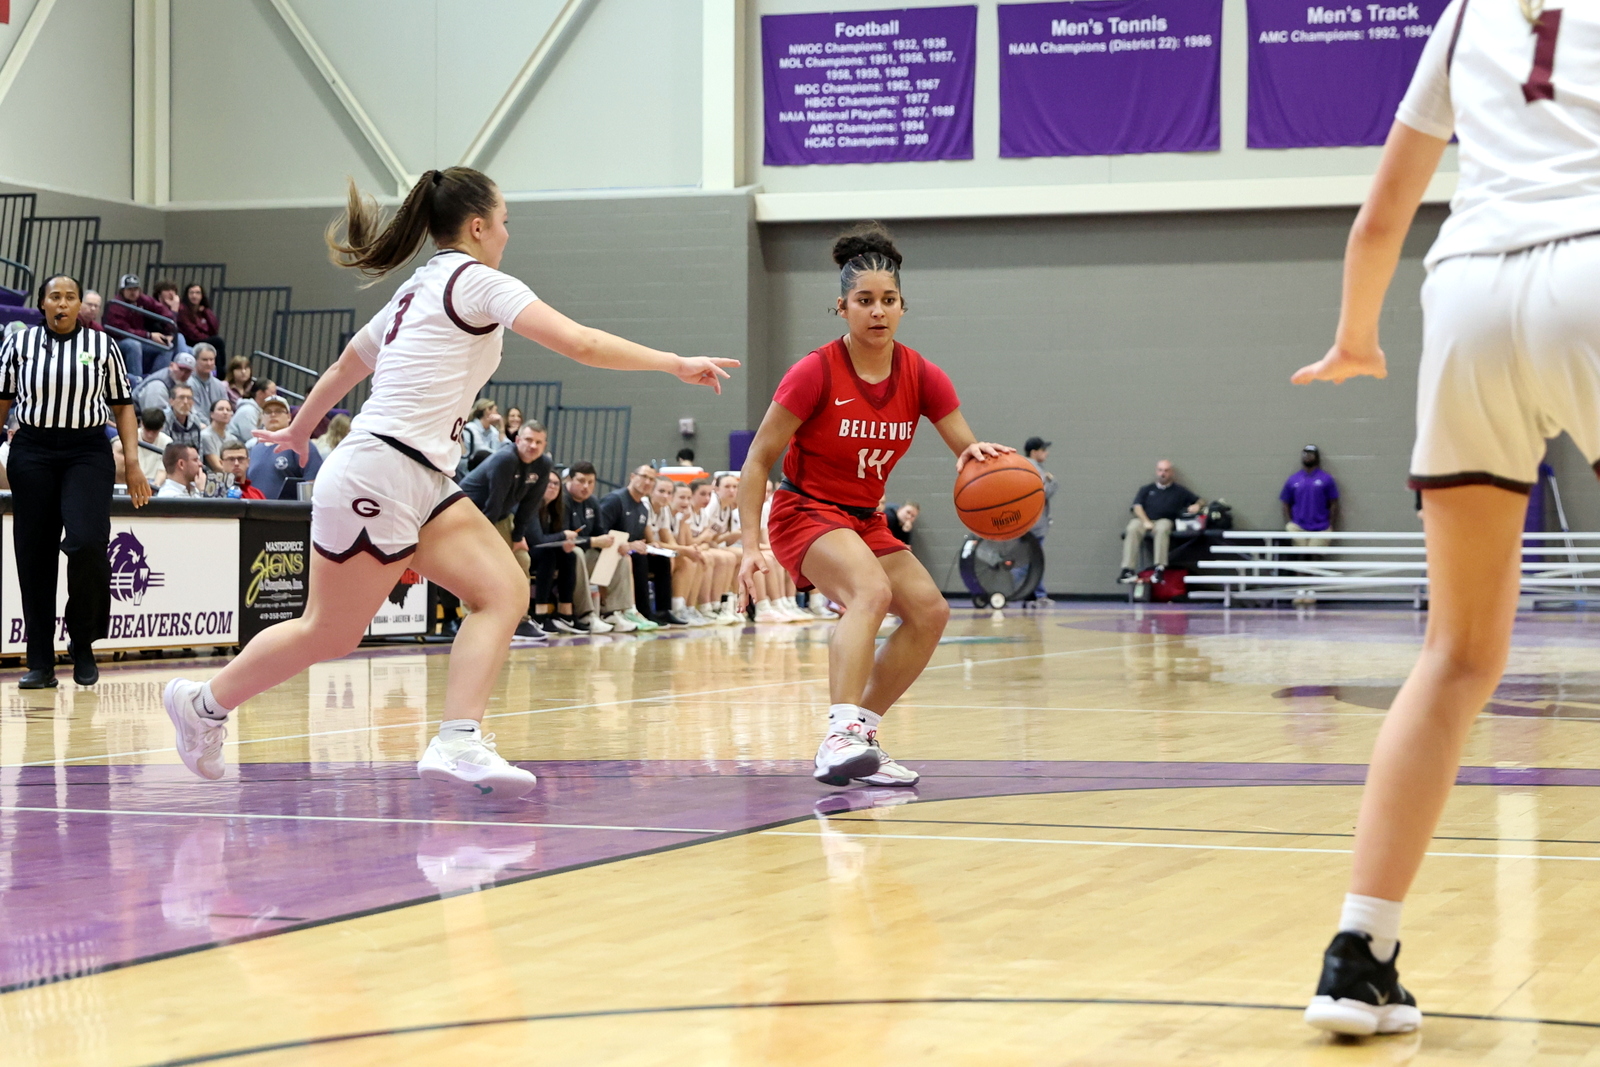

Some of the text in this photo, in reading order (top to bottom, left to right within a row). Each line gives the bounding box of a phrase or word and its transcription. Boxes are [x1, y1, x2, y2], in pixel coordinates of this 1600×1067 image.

[1307, 2, 1419, 24] Men's Track
[835, 20, 899, 38] Football
[1051, 14, 1167, 37] Men's Tennis
[1259, 30, 1288, 44] AMC
[1290, 29, 1365, 44] Champions:
[1368, 26, 1400, 40] 1992,
[825, 41, 887, 54] Champions:
[1008, 42, 1039, 55] NAIA
[1040, 41, 1107, 55] Champions
[1108, 37, 1156, 54] (District
[805, 55, 867, 69] Champions:
[1521, 8, 1563, 104] 1
[794, 83, 820, 95] MOC
[822, 82, 884, 95] Champions:
[837, 94, 899, 108] Champions:
[806, 109, 850, 121] National
[850, 107, 896, 122] Playoffs:
[809, 123, 834, 135] AMC
[835, 122, 898, 135] Champions:
[837, 135, 899, 148] Champions:
[385, 292, 414, 346] 3
[838, 418, 913, 441] BELLEVUE
[857, 448, 895, 480] 14
[352, 497, 381, 517] G
